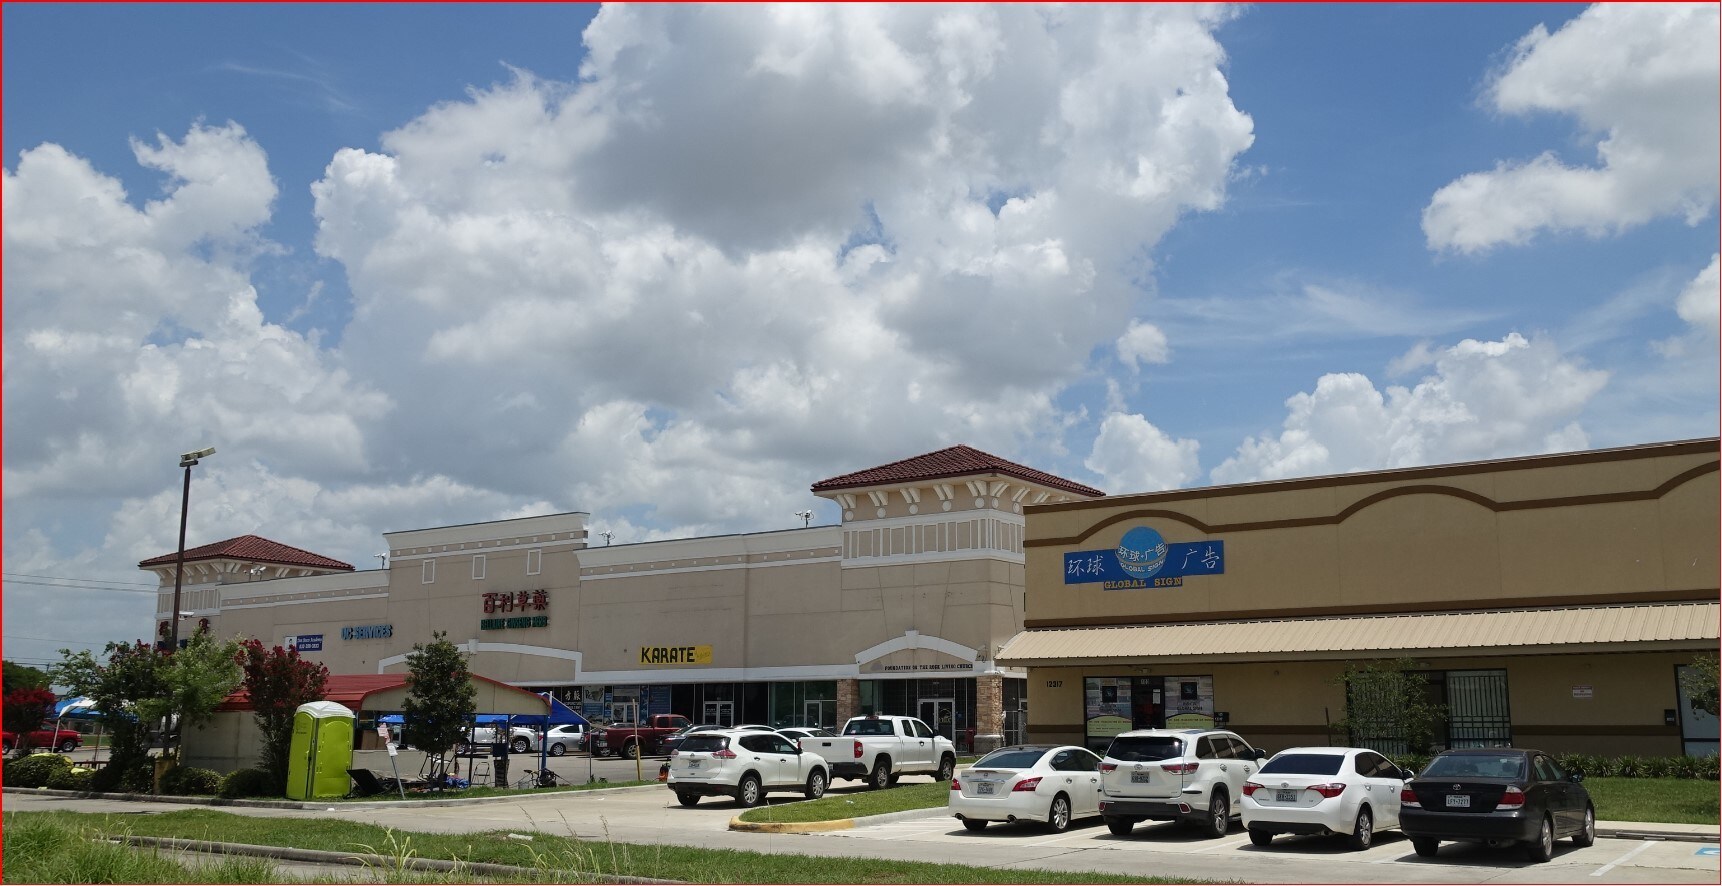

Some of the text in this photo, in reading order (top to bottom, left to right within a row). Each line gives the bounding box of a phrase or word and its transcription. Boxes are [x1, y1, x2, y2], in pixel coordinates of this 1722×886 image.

[1067, 545, 1220, 577] 环球 广告
[1121, 559, 1165, 573] GLOBAL SIGN
[1104, 577, 1182, 589] GLOBAL SIGN
[354, 624, 393, 639] SERVICES
[640, 646, 696, 664] KARATE
[1046, 680, 1063, 688] 12317
